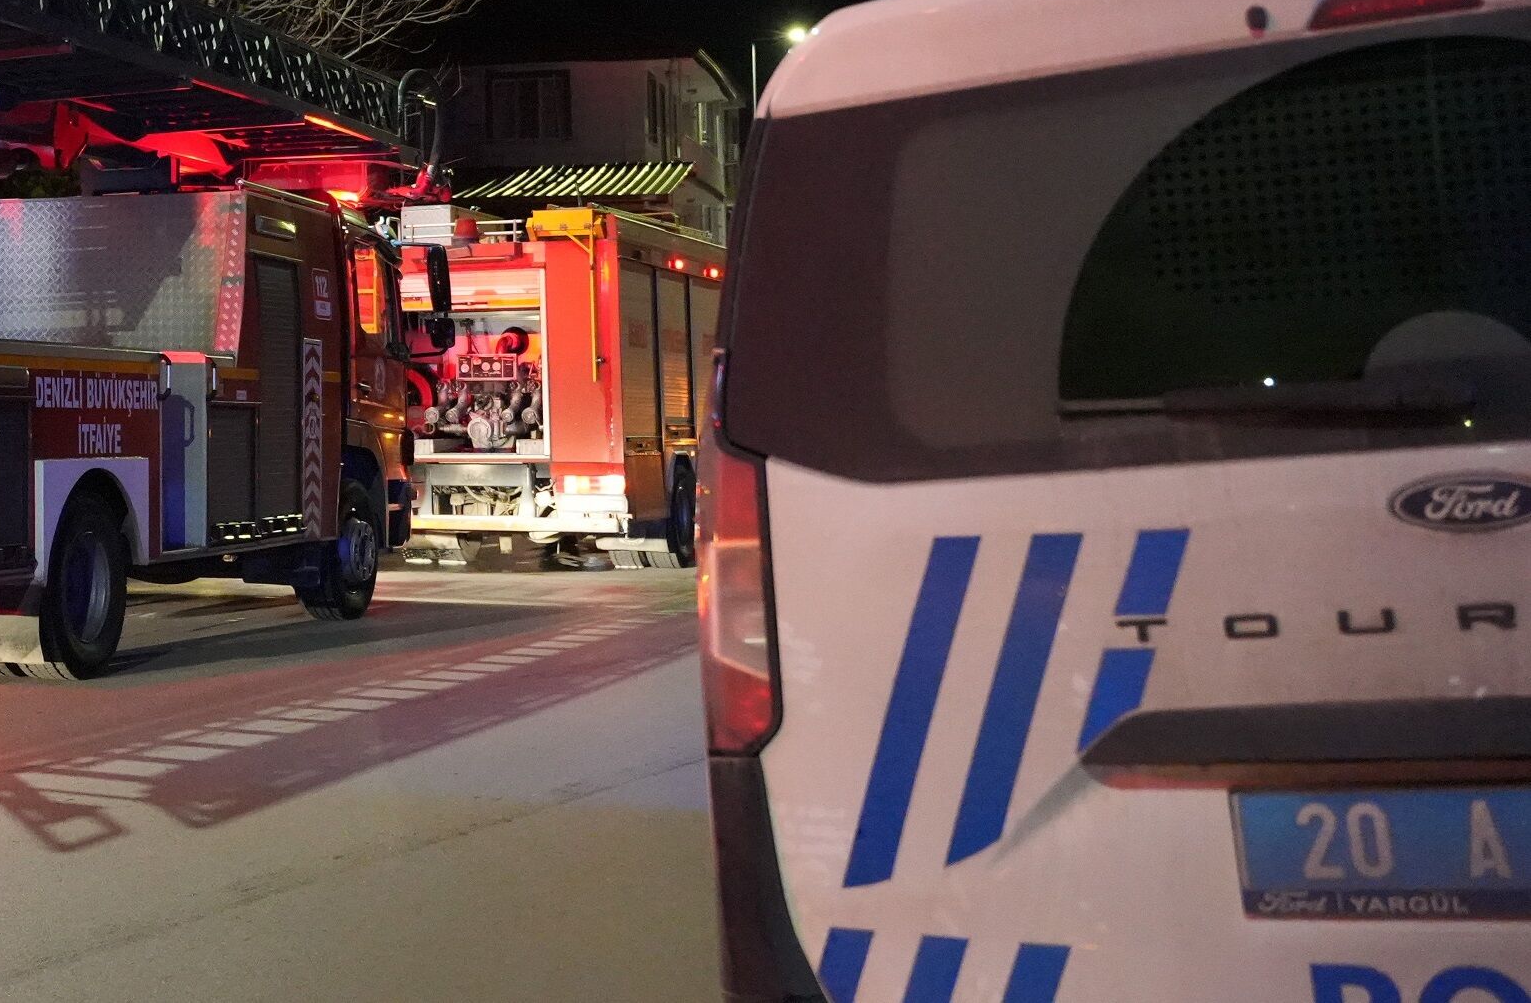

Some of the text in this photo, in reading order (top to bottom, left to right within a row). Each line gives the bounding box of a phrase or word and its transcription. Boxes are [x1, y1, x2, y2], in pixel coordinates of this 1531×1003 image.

[314, 275, 329, 299] 112
[35, 369, 159, 418] DENİZLİ BÜYÜKŞEHİR
[78, 416, 123, 455] İTFAİYE
[1424, 484, 1521, 520] Ford
[1294, 799, 1513, 880] 20 A
